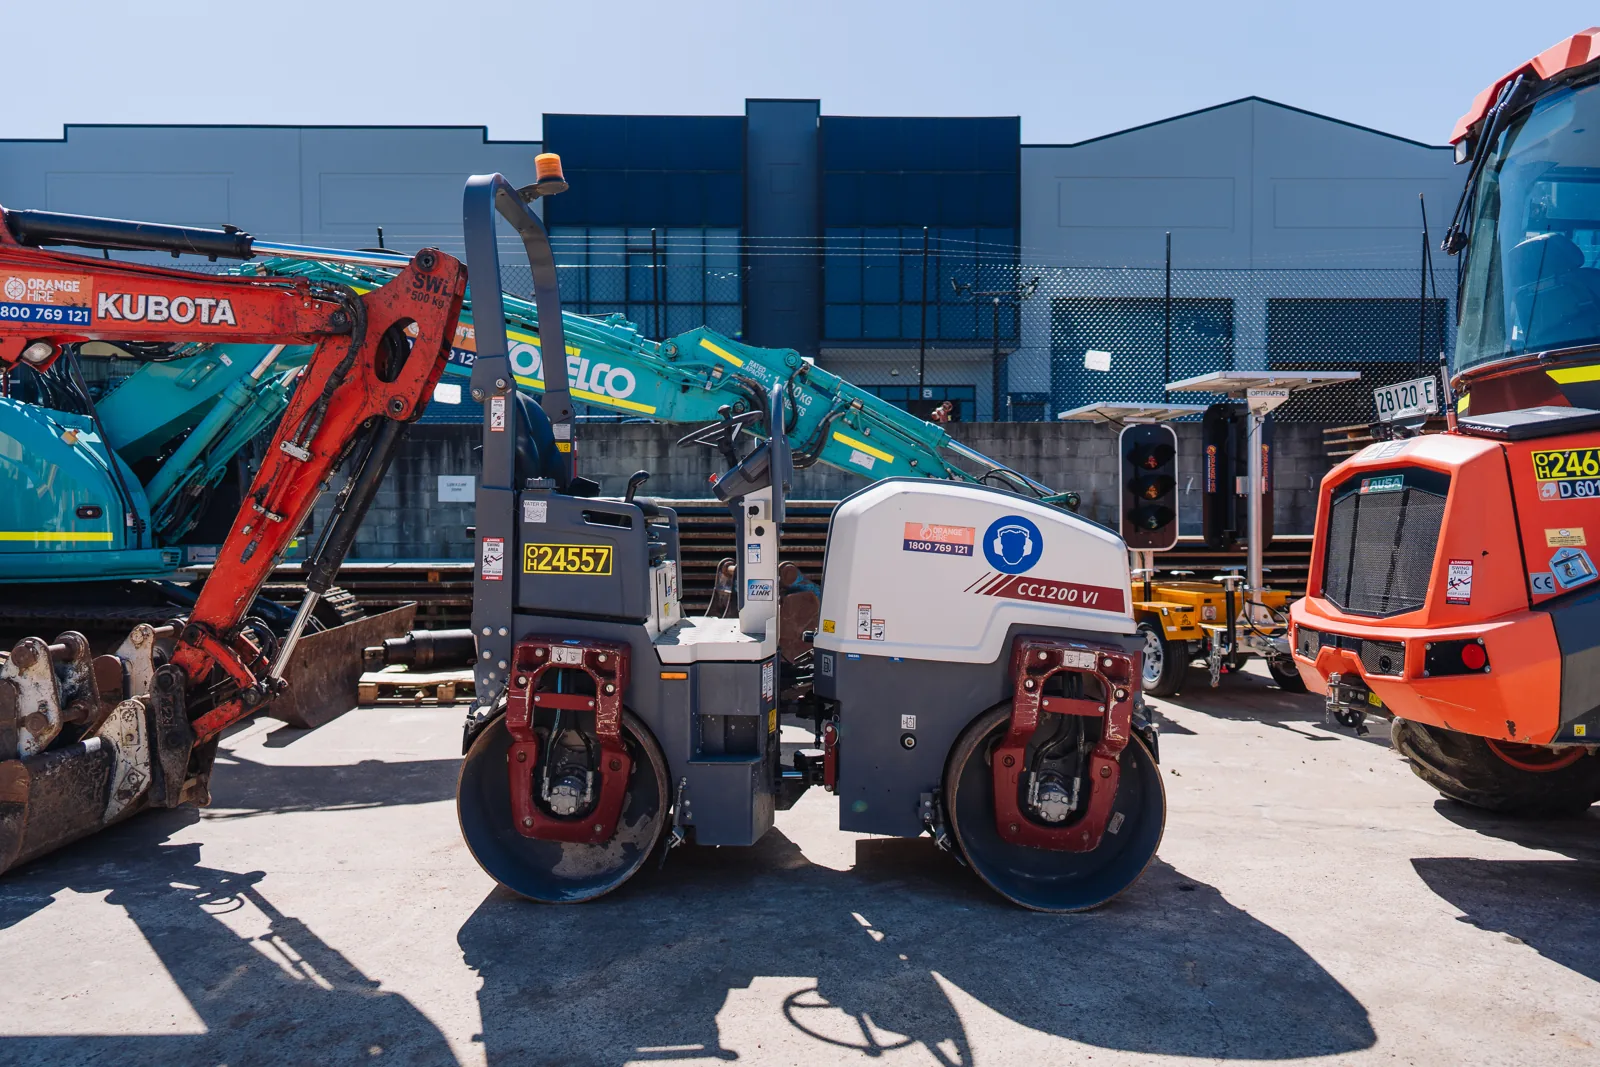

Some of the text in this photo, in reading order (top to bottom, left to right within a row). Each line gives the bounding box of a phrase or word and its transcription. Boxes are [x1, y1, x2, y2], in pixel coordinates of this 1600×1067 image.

[27, 278, 80, 293] ORANGE
[412, 272, 452, 297] SWL
[27, 290, 55, 303] HIRE
[411, 291, 445, 309] 500 kg
[0, 306, 89, 323] 800 769 121
[98, 292, 237, 325] KUBOTA
[507, 340, 636, 399] OELCO
[741, 364, 767, 381] CAPACITY
[748, 360, 767, 373] RATED
[1548, 450, 1600, 478] 246
[1370, 477, 1401, 489] AUSA
[1559, 482, 1572, 497] D
[933, 527, 963, 536] ORANGE
[908, 541, 968, 554] 1800 769 121
[538, 546, 609, 572] 24557
[1017, 583, 1099, 605] CC1200 VI
